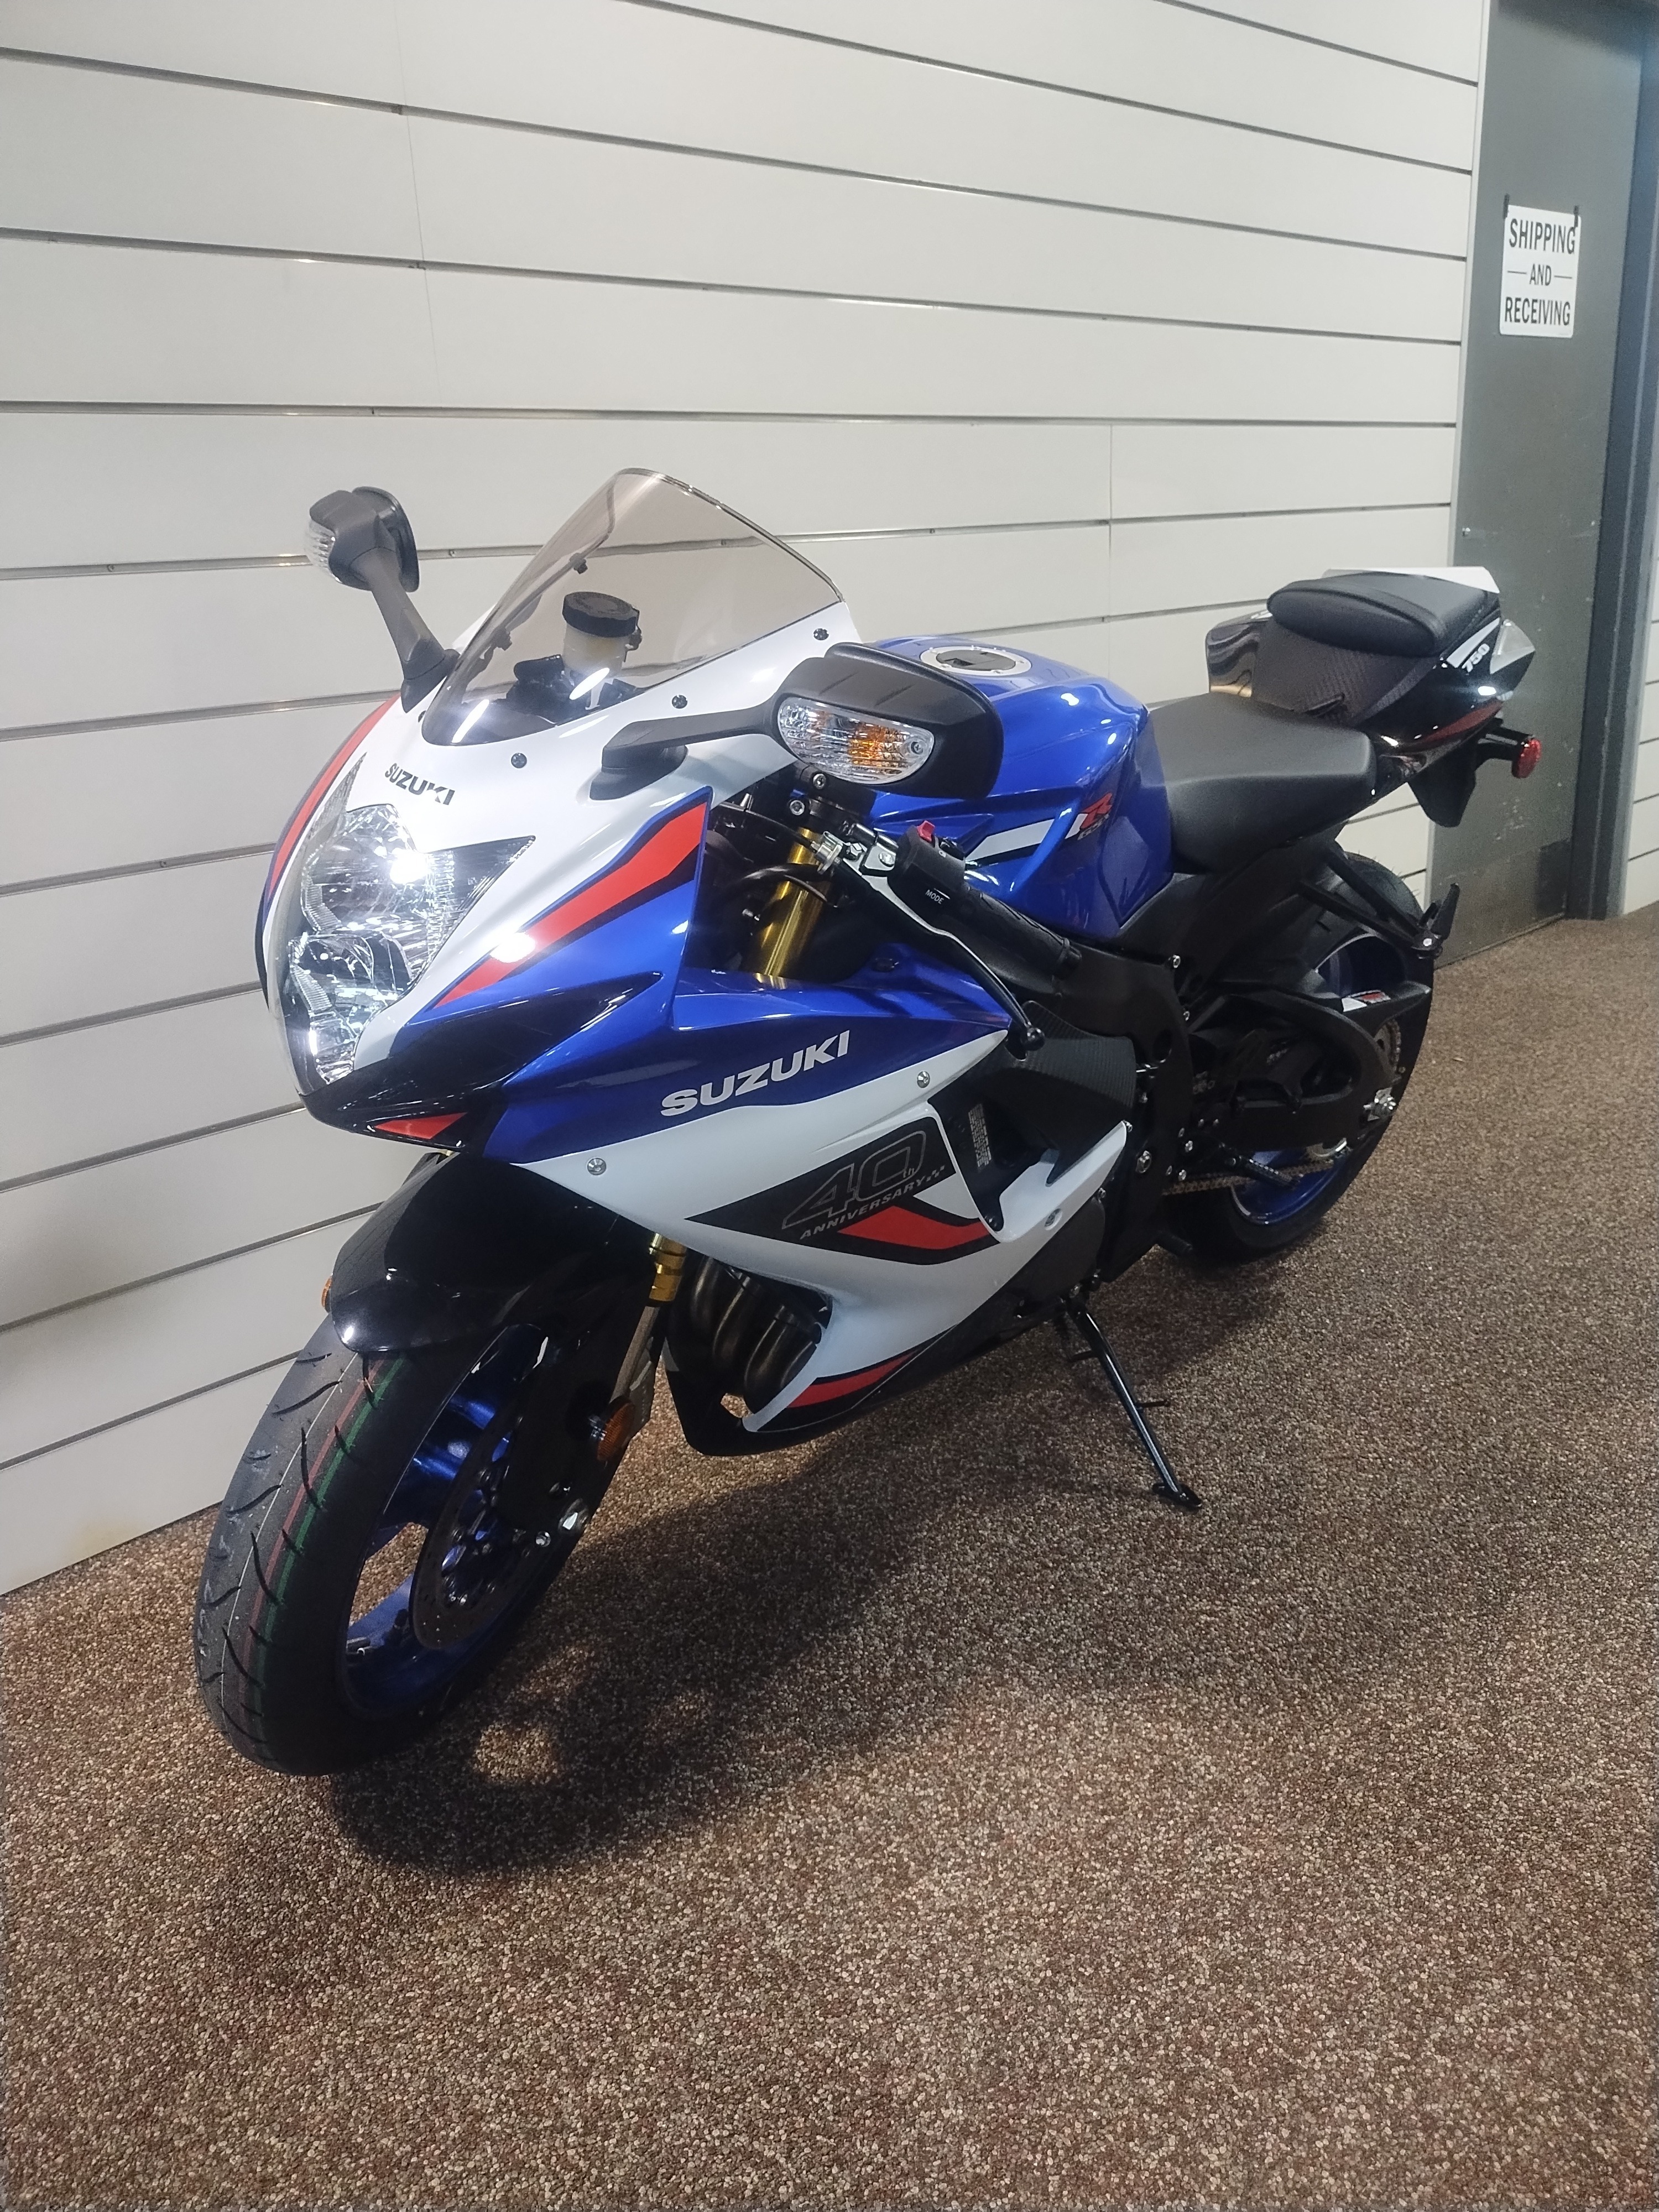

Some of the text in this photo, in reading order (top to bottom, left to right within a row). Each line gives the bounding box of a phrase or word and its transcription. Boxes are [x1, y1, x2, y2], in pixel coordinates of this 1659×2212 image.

[1509, 218, 1576, 254] SHIPPING
[1530, 263, 1552, 286] AND
[1505, 296, 1571, 326] RECEIVING
[1462, 643, 1490, 672] 750
[384, 763, 455, 805] SUZUKI
[925, 889, 945, 905] MODE
[661, 1030, 850, 1117] SUZUKI
[800, 1176, 925, 1240] ANNIVERSARY
